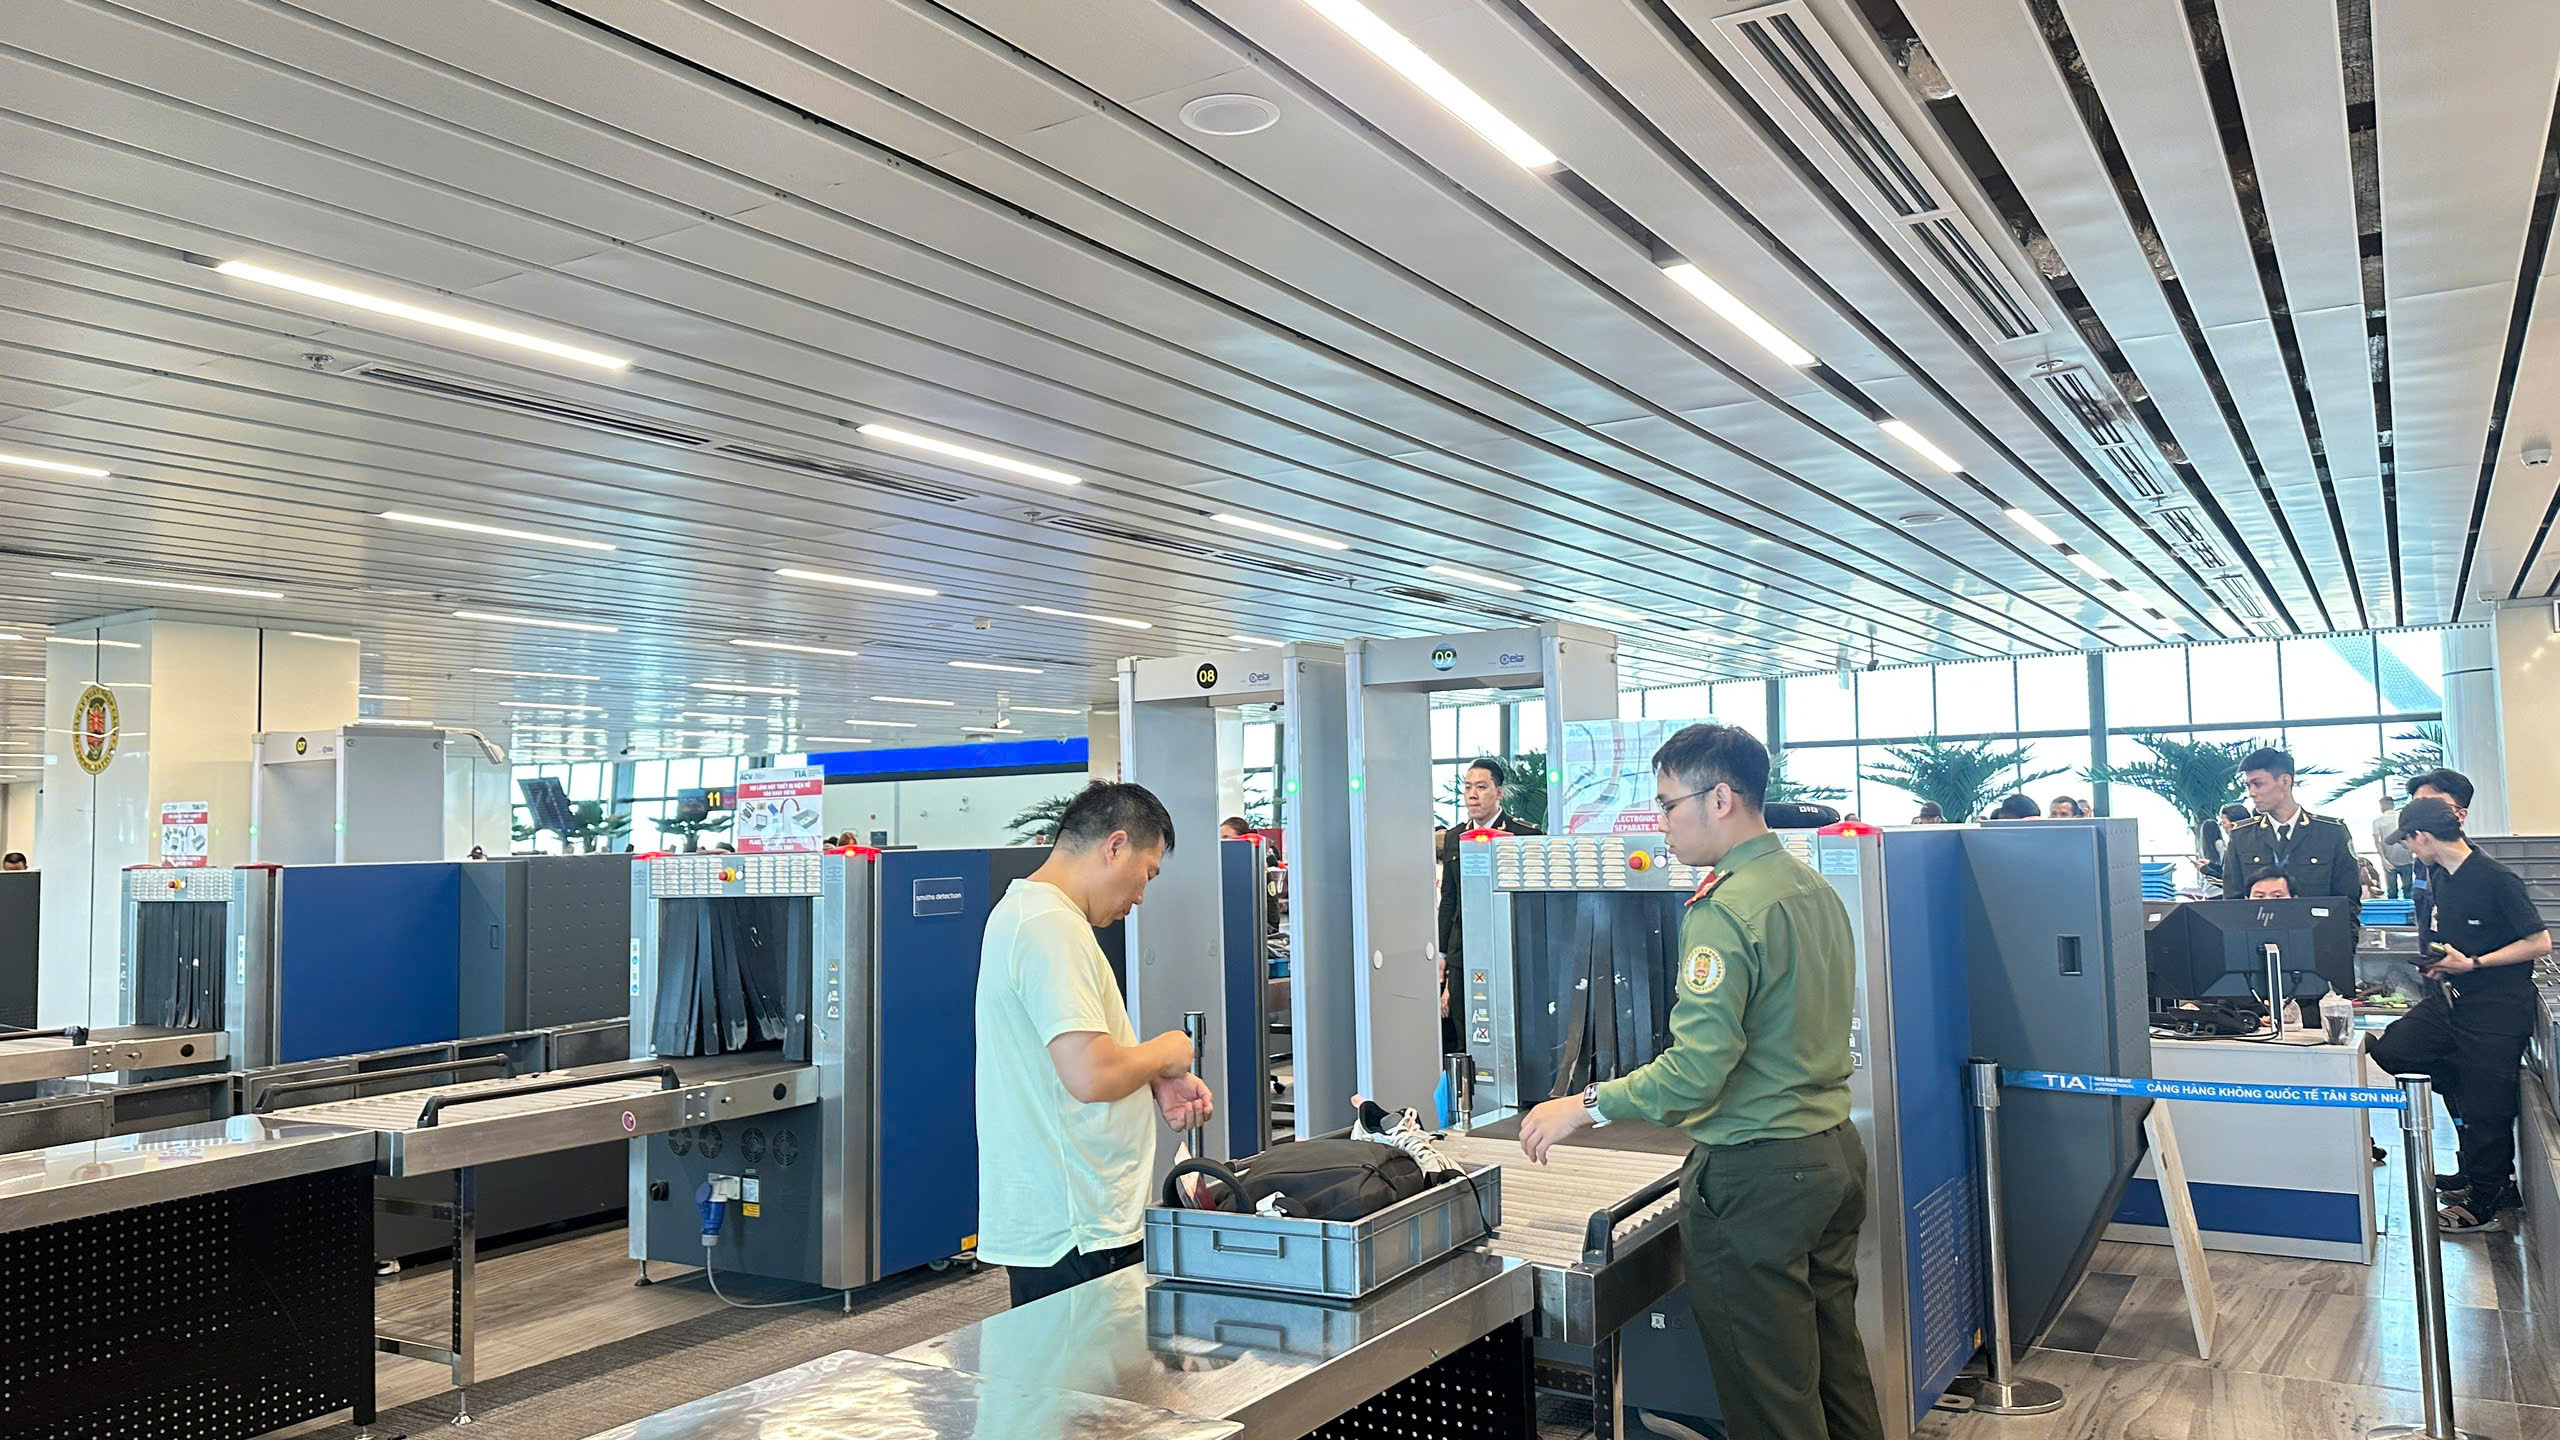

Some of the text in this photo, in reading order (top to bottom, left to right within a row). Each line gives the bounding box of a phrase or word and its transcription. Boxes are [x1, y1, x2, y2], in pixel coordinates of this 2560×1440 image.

[1436, 651, 1453, 665] 09
[1200, 670, 1215, 683] 08
[708, 792, 720, 806] 11
[2042, 1074, 2087, 1090] TIA
[2183, 1084, 2215, 1095] HÀNG
[2219, 1086, 2261, 1098] KHÔNG
[2265, 1087, 2300, 1099] QUỐC
[2304, 1088, 2319, 1100] TẾ
[2322, 1089, 2347, 1101] TÂN
